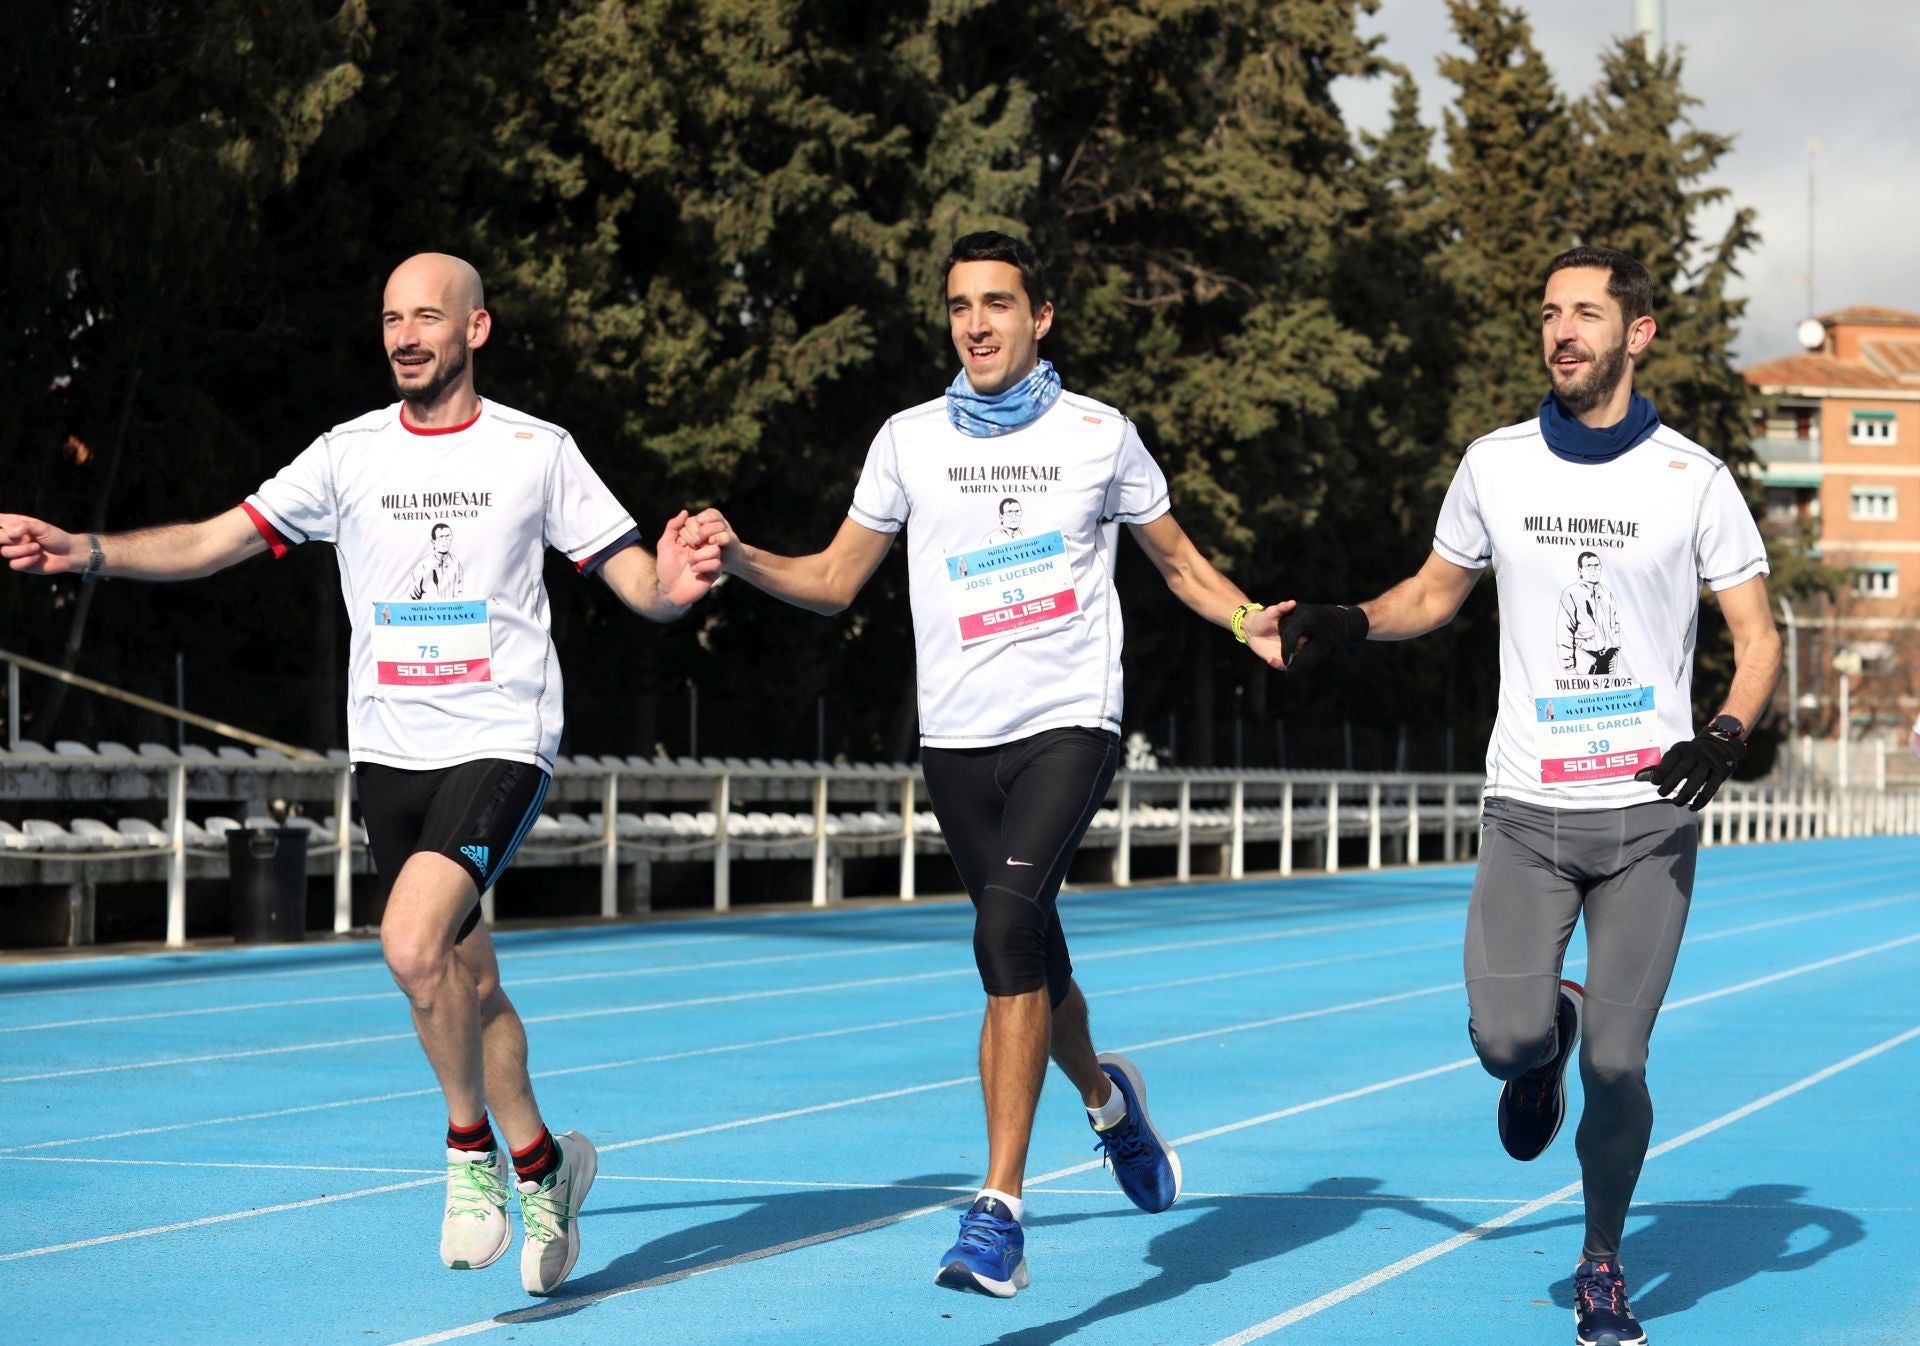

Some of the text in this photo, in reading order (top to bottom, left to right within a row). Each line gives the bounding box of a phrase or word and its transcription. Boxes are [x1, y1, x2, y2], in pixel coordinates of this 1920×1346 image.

[947, 465, 1062, 481] MILLA HOMENAJE
[1002, 484, 1048, 493] VELASCO
[381, 491, 493, 509] MILLA HOMENAJE
[434, 509, 479, 519] VELASCO
[1524, 516, 1640, 538] MILLA HOMENAJE
[1580, 538, 1624, 549] VELASCO
[1015, 545, 1055, 560] VELASCO
[1002, 588, 1025, 604] 53
[437, 612, 477, 621] VELASCO
[981, 597, 1056, 626] SOLISS
[418, 645, 439, 659] 75
[397, 663, 468, 677] SOLISS
[1555, 679, 1590, 690] TOLEDO
[1551, 723, 1593, 735] DANIEL
[1587, 739, 1610, 755] 39
[1563, 753, 1639, 773] SOLISS
[460, 846, 487, 877] adidas
